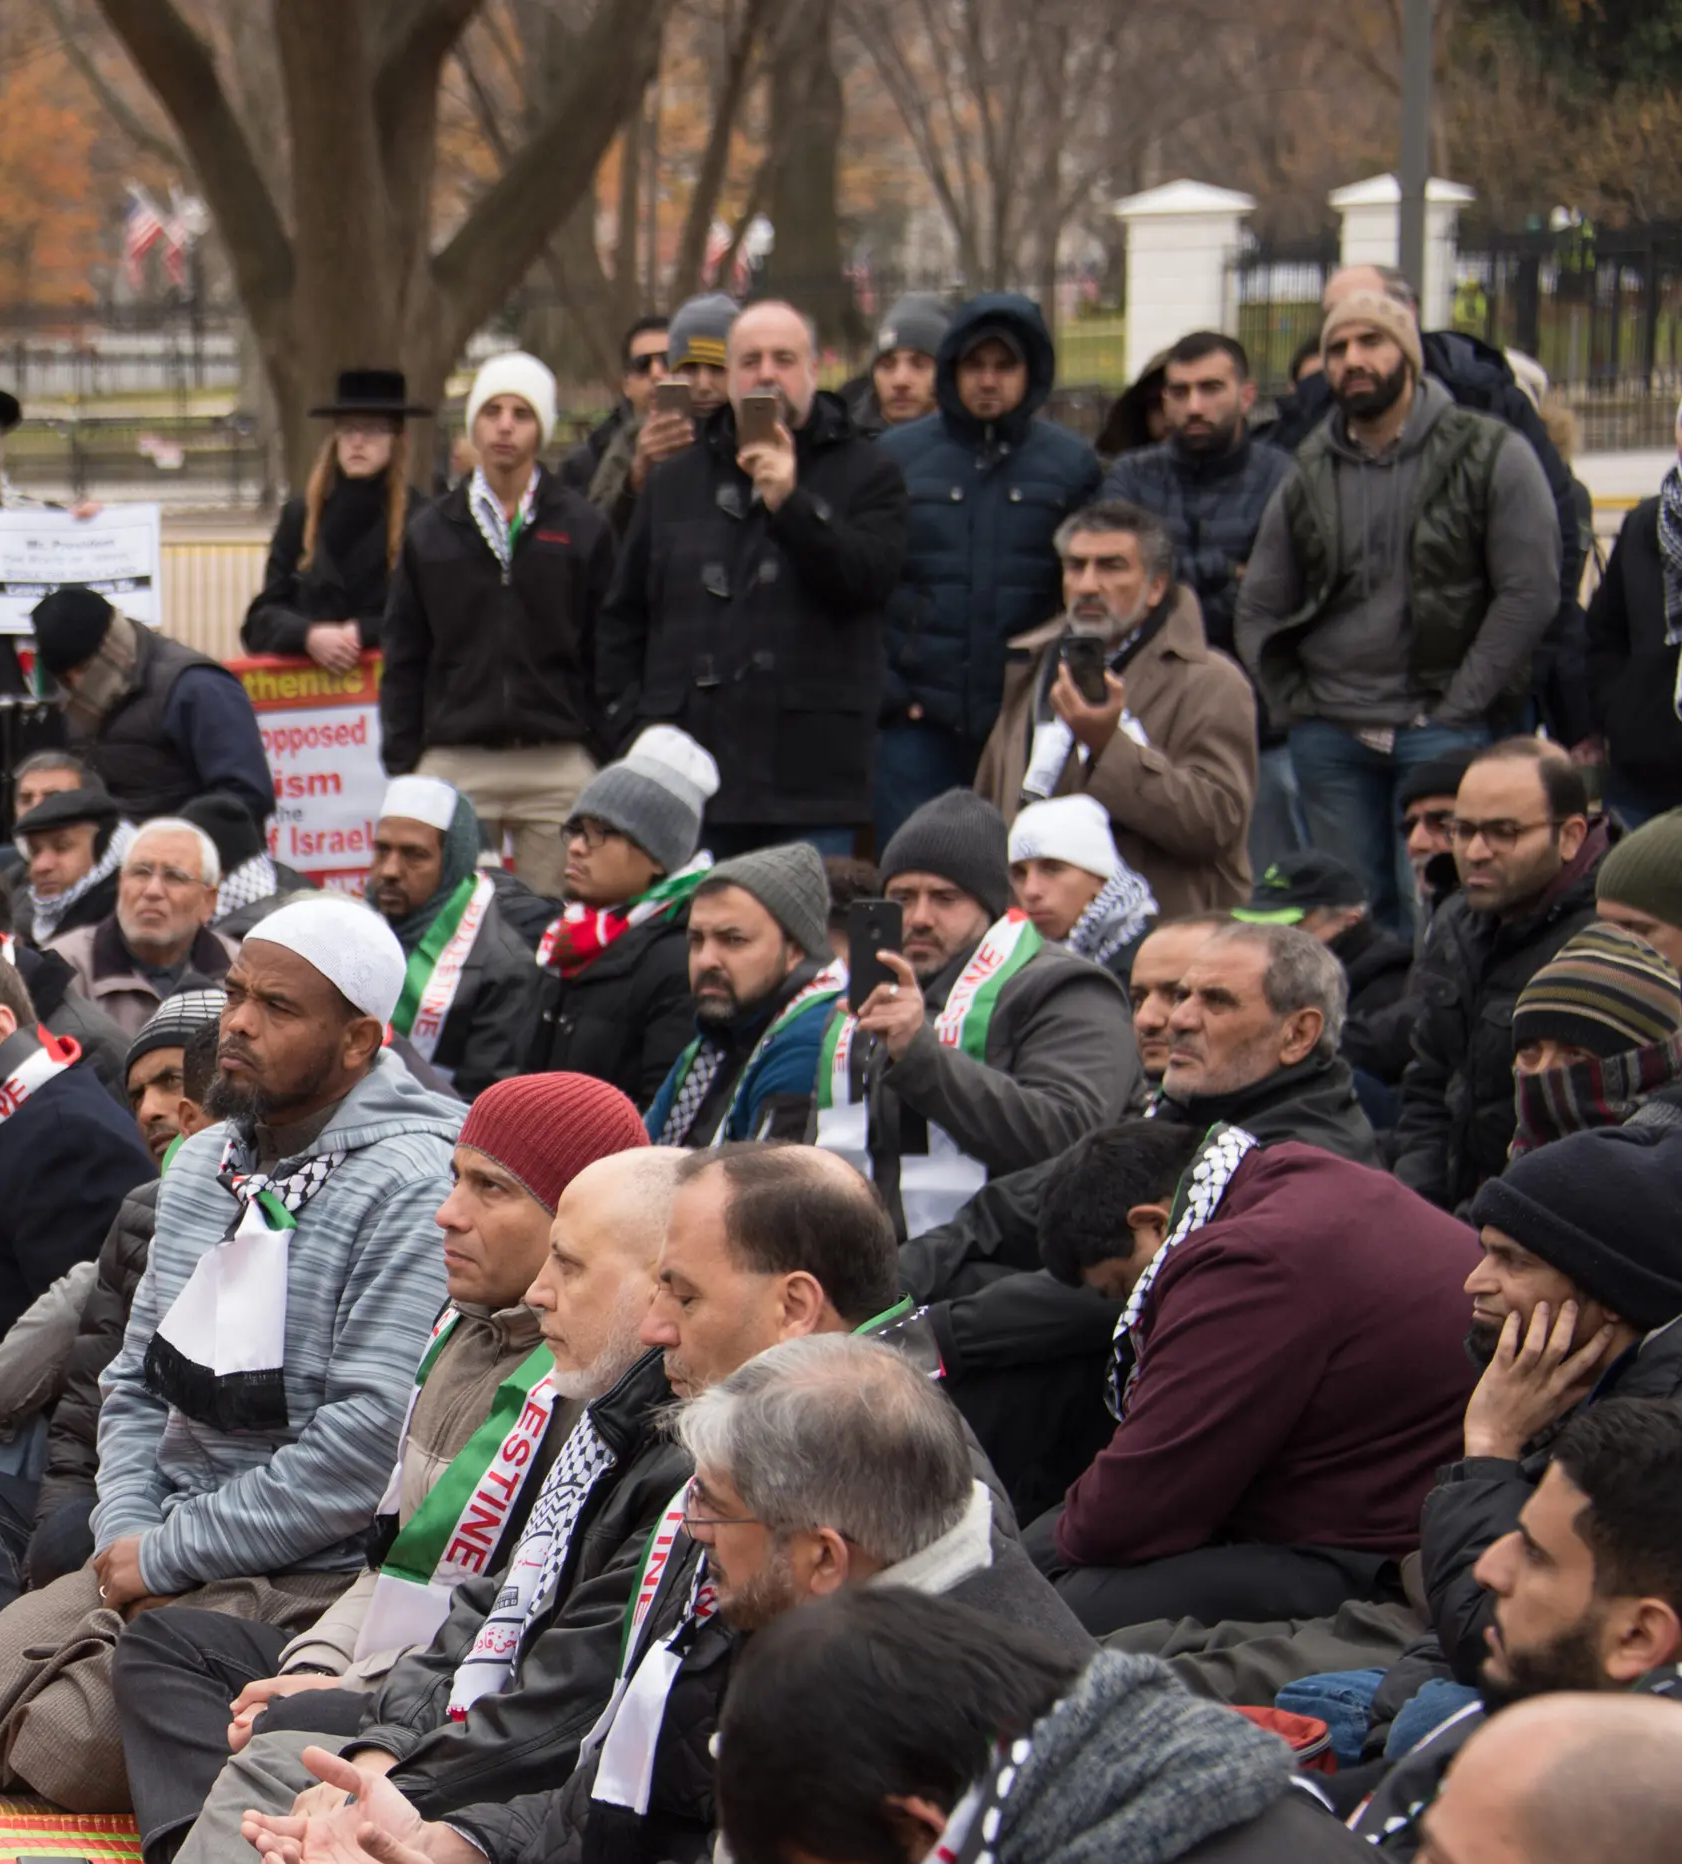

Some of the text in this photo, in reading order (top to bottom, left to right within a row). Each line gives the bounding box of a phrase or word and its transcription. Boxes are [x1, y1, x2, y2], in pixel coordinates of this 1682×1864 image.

[244, 667, 364, 700] thentic
[275, 770, 342, 799] ism
[291, 822, 374, 858] Israel
